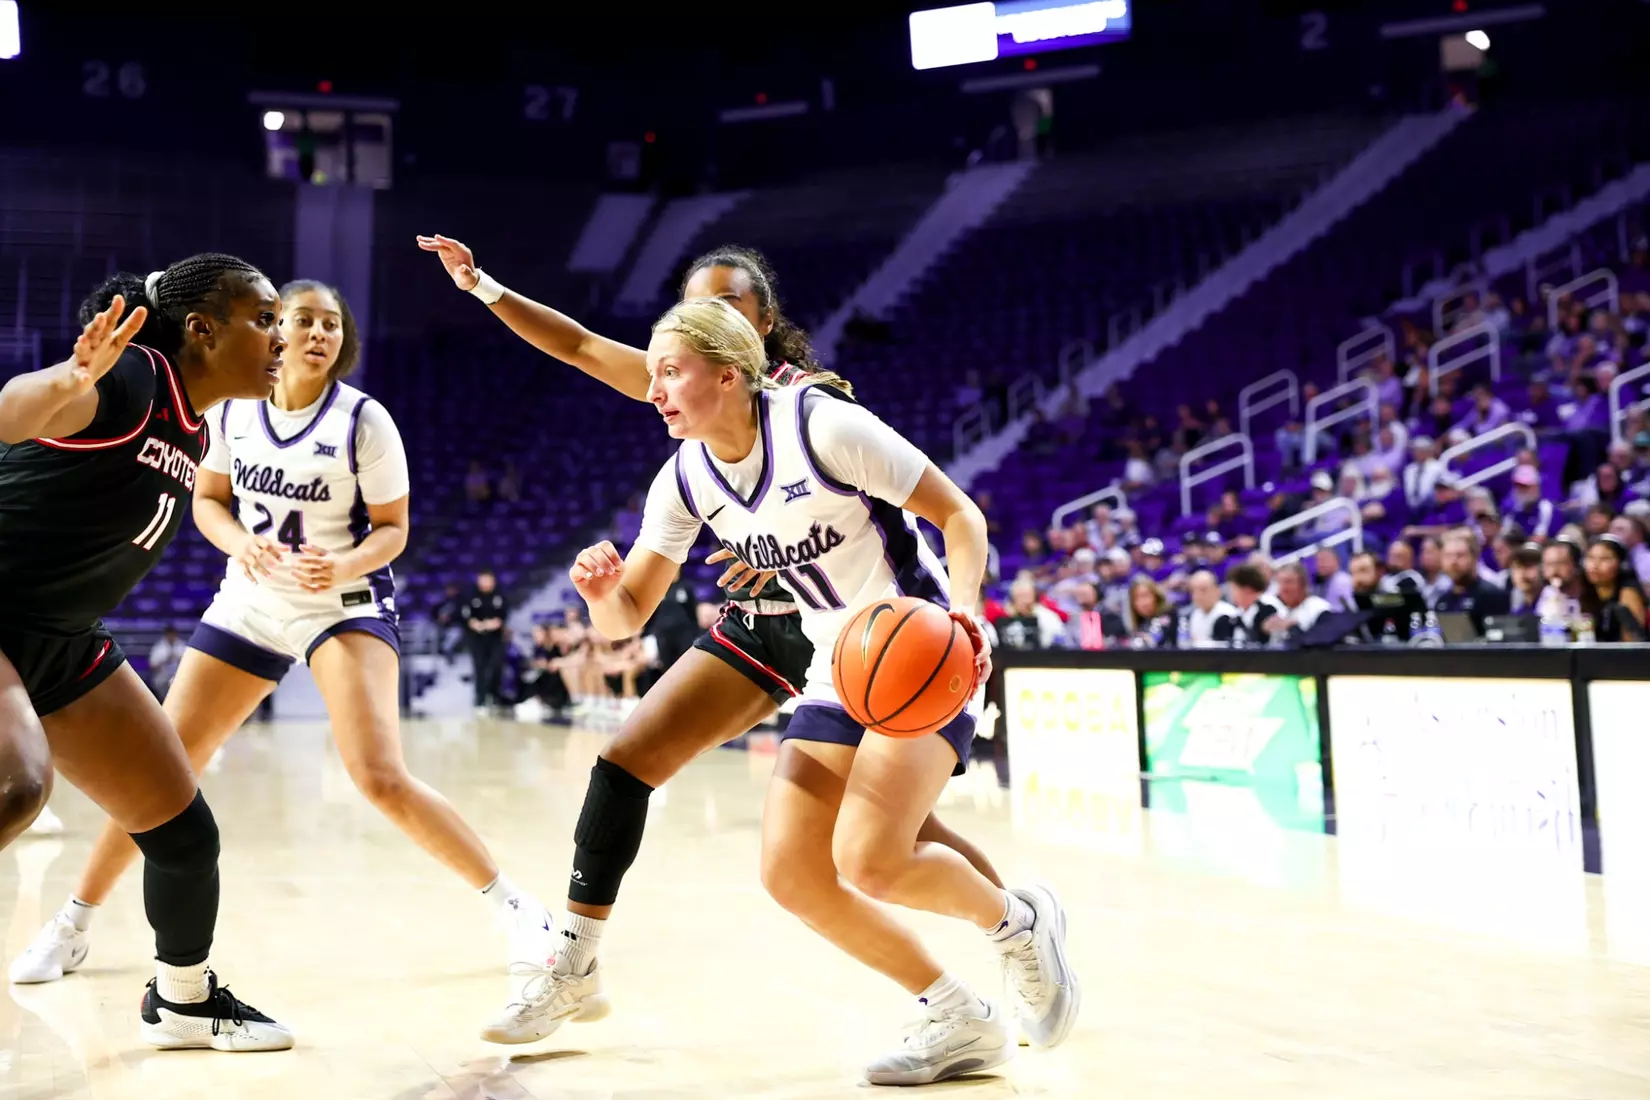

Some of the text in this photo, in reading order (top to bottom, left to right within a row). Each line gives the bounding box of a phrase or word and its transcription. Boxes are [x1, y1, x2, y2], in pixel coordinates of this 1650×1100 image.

[81, 59, 147, 99] 26
[524, 84, 579, 123] 27
[234, 457, 332, 502] Wildcats
[131, 492, 176, 552] 11
[252, 501, 307, 554] 24
[721, 520, 846, 570] Wildcats
[776, 562, 847, 610] 11
